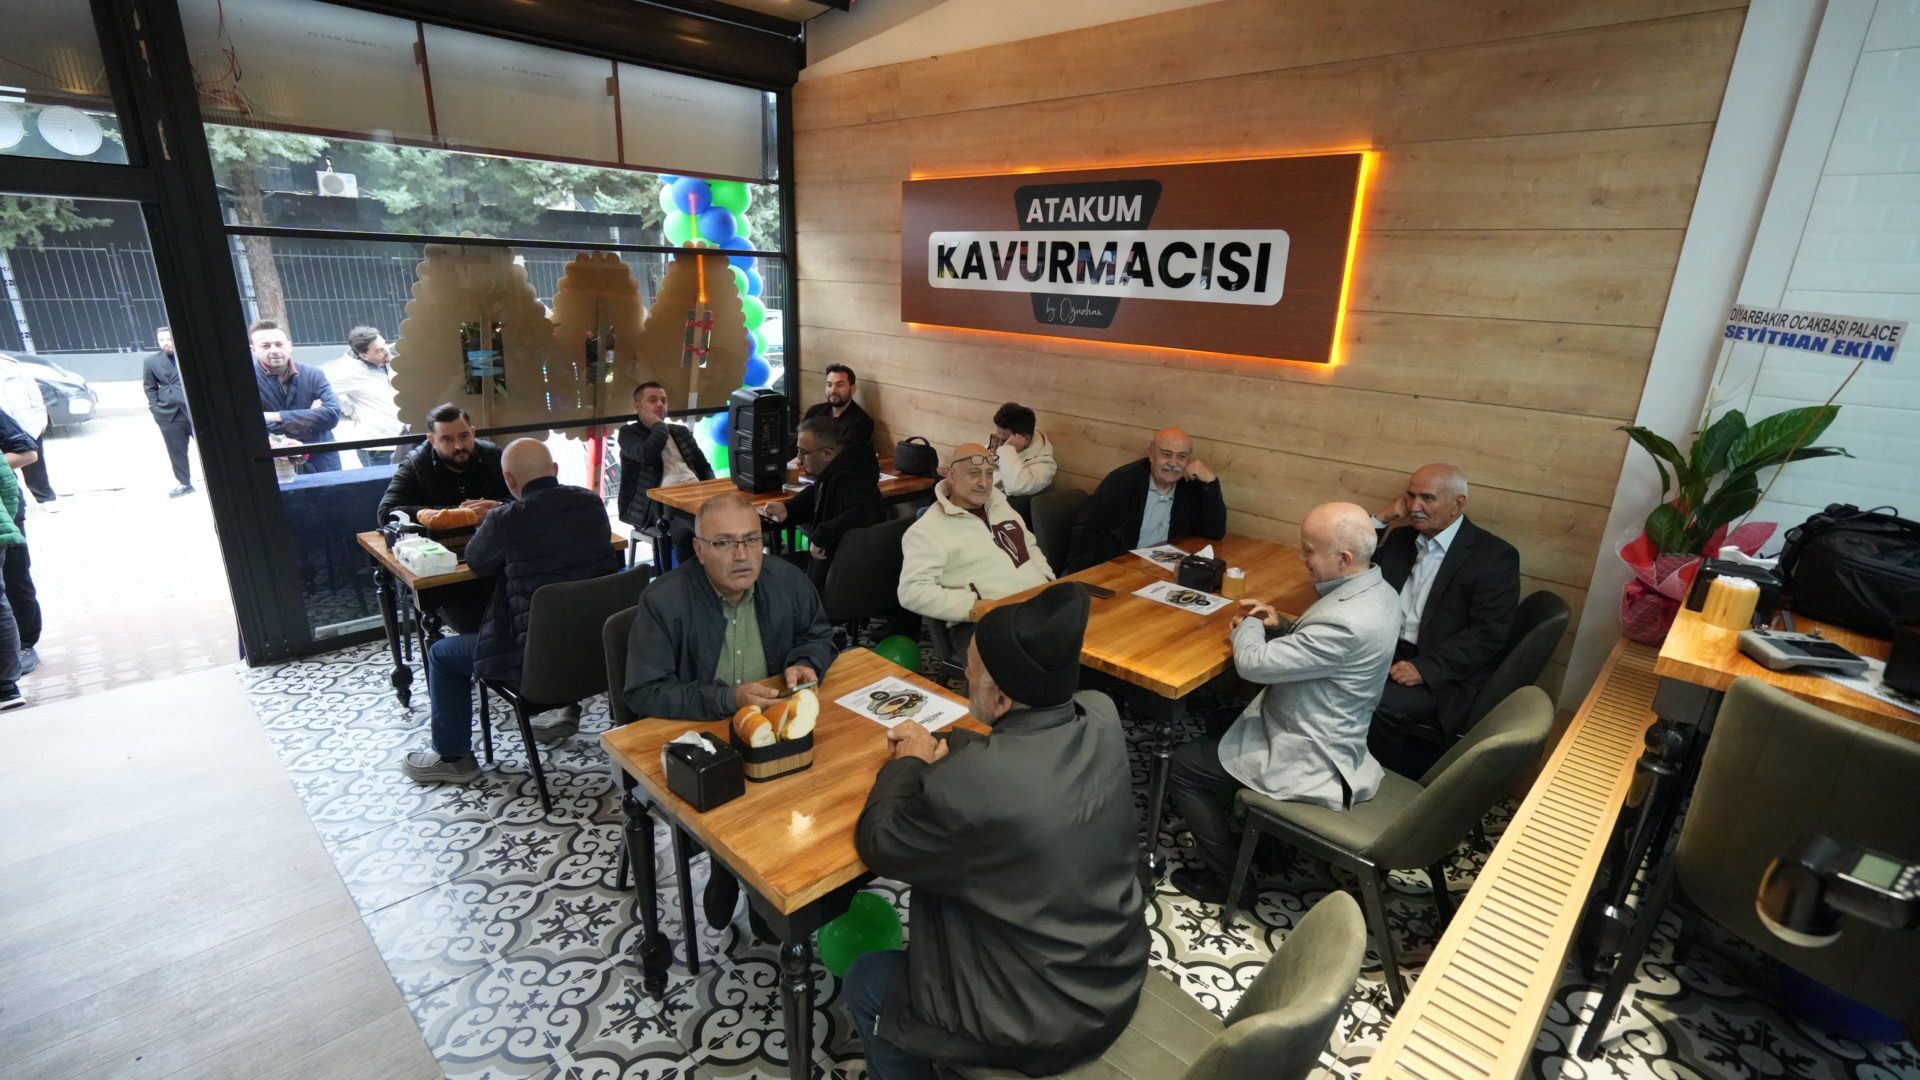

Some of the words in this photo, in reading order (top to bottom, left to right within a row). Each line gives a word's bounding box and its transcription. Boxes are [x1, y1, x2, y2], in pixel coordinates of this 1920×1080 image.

[1026, 195, 1143, 223] ATAKUM
[937, 241, 1272, 293] KAVURMACISI
[1046, 297, 1057, 322] by
[1729, 307, 1789, 326] DİYARBAKIR
[1789, 315, 1846, 338] OCAKBAŞI
[1847, 323, 1901, 342] PALACE
[1724, 324, 1826, 352] SEYİTHAN
[1831, 338, 1895, 362] EKİN
